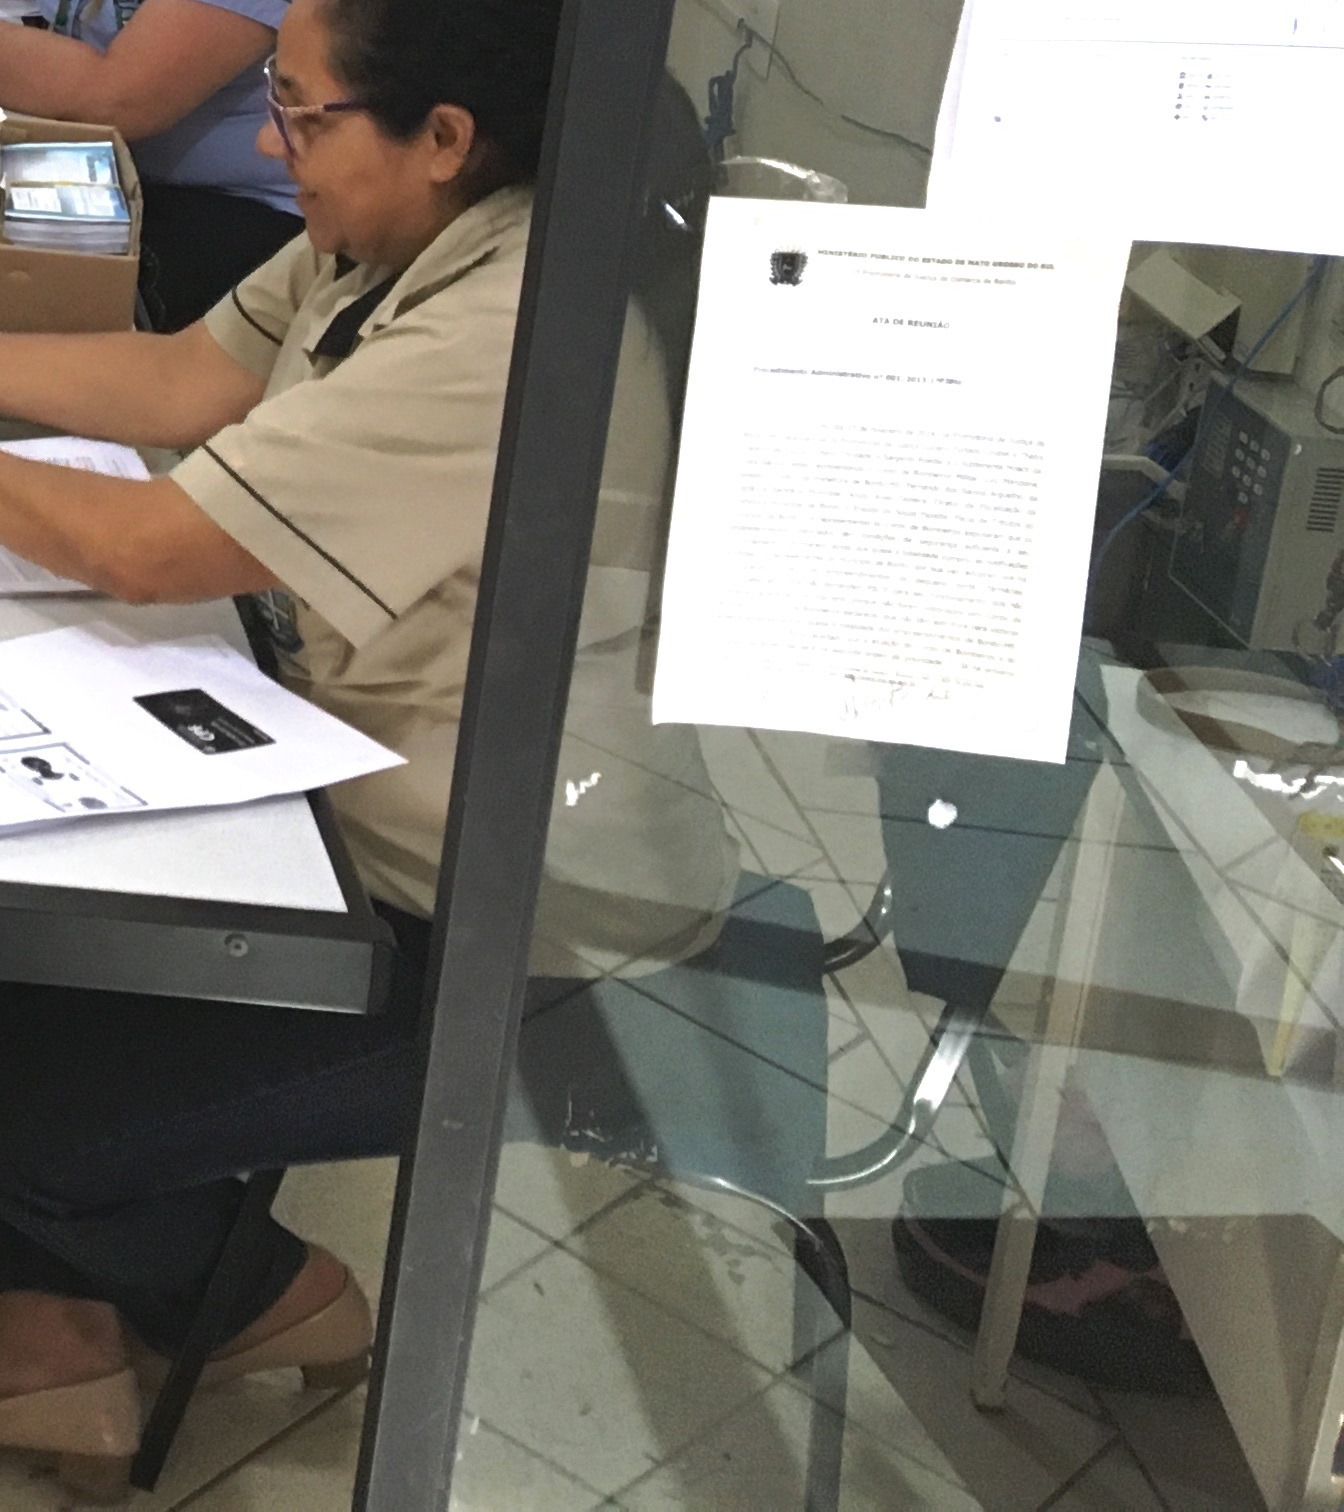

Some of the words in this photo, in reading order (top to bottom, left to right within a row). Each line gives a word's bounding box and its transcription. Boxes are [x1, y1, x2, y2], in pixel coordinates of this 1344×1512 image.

[817, 249, 868, 258] MINISTÉRIO
[922, 257, 954, 265] ESTADO
[968, 259, 991, 267] MATO
[872, 316, 890, 325] ATA
[893, 318, 904, 326] DE
[907, 319, 950, 329] REUNIÃO
